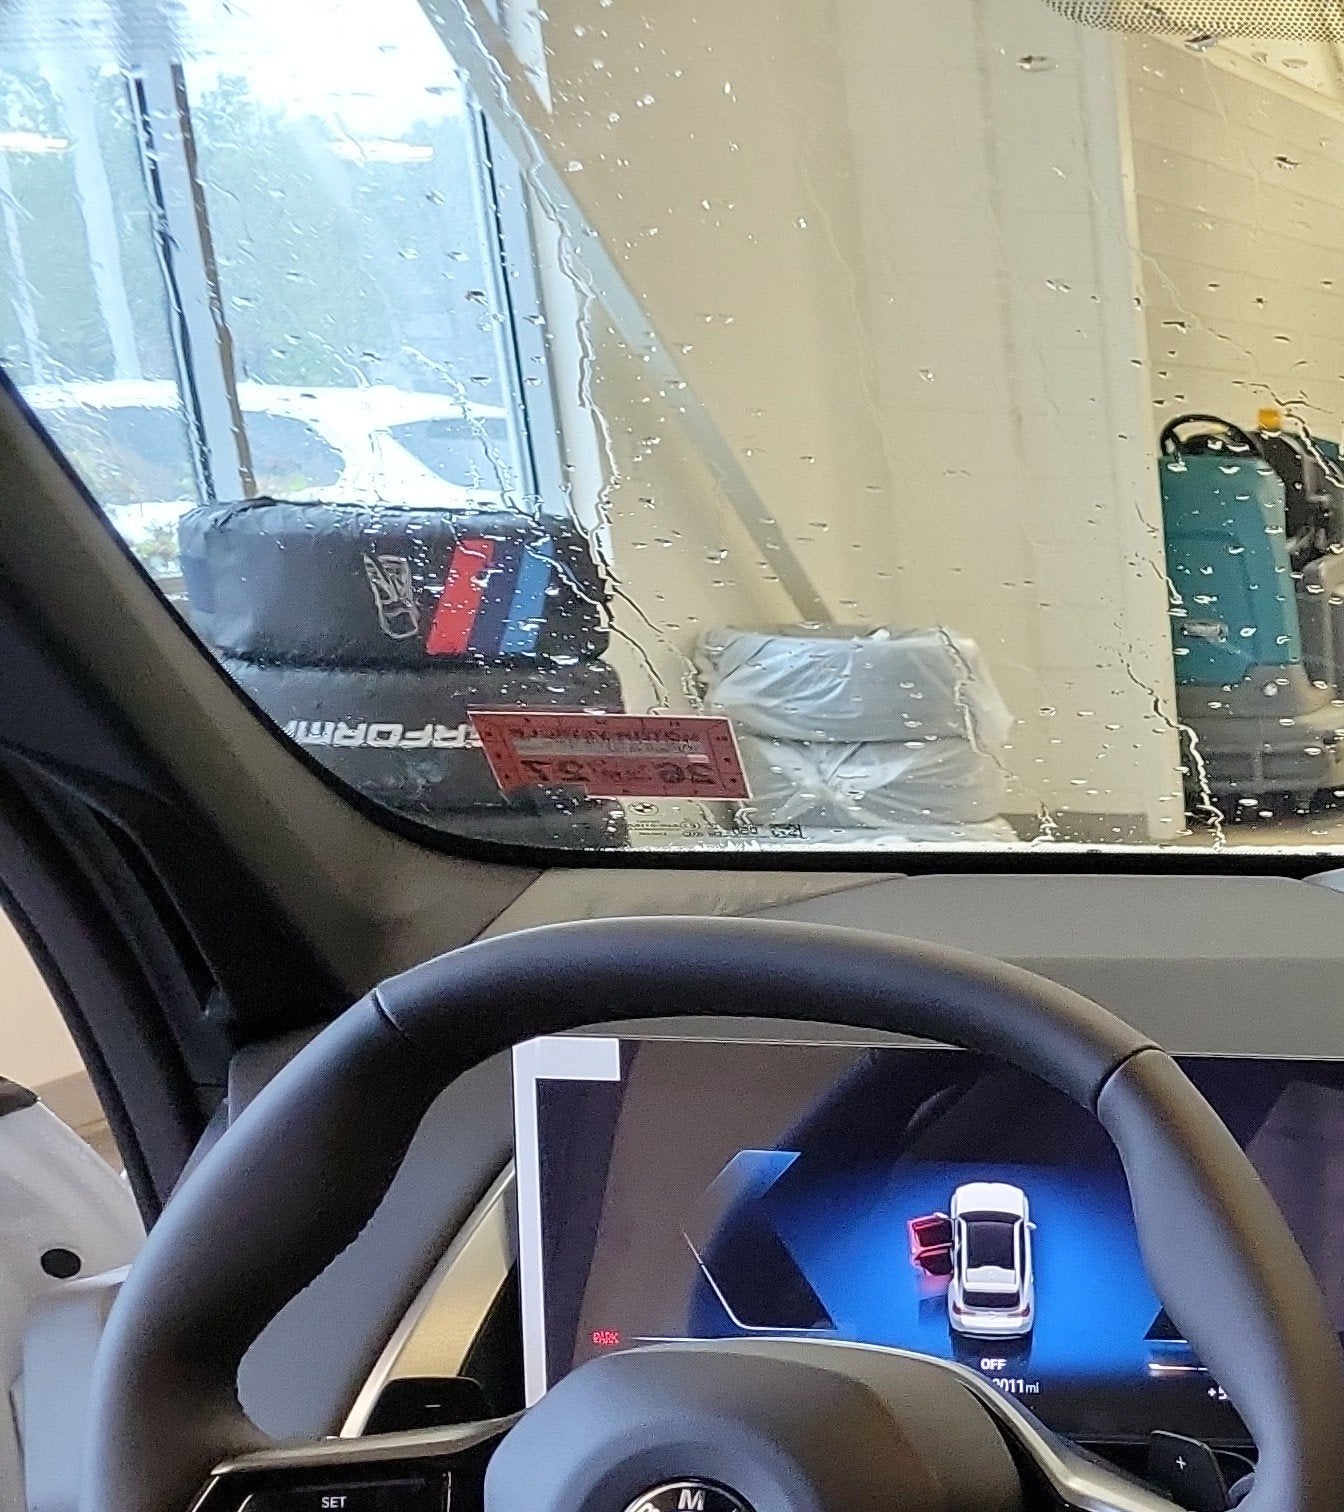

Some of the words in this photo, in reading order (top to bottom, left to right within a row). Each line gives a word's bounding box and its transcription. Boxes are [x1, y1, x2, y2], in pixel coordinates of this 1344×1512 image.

[980, 1358, 1007, 1370] OFF
[1026, 1382, 1040, 1394] mi
[321, 1496, 348, 1509] SET
